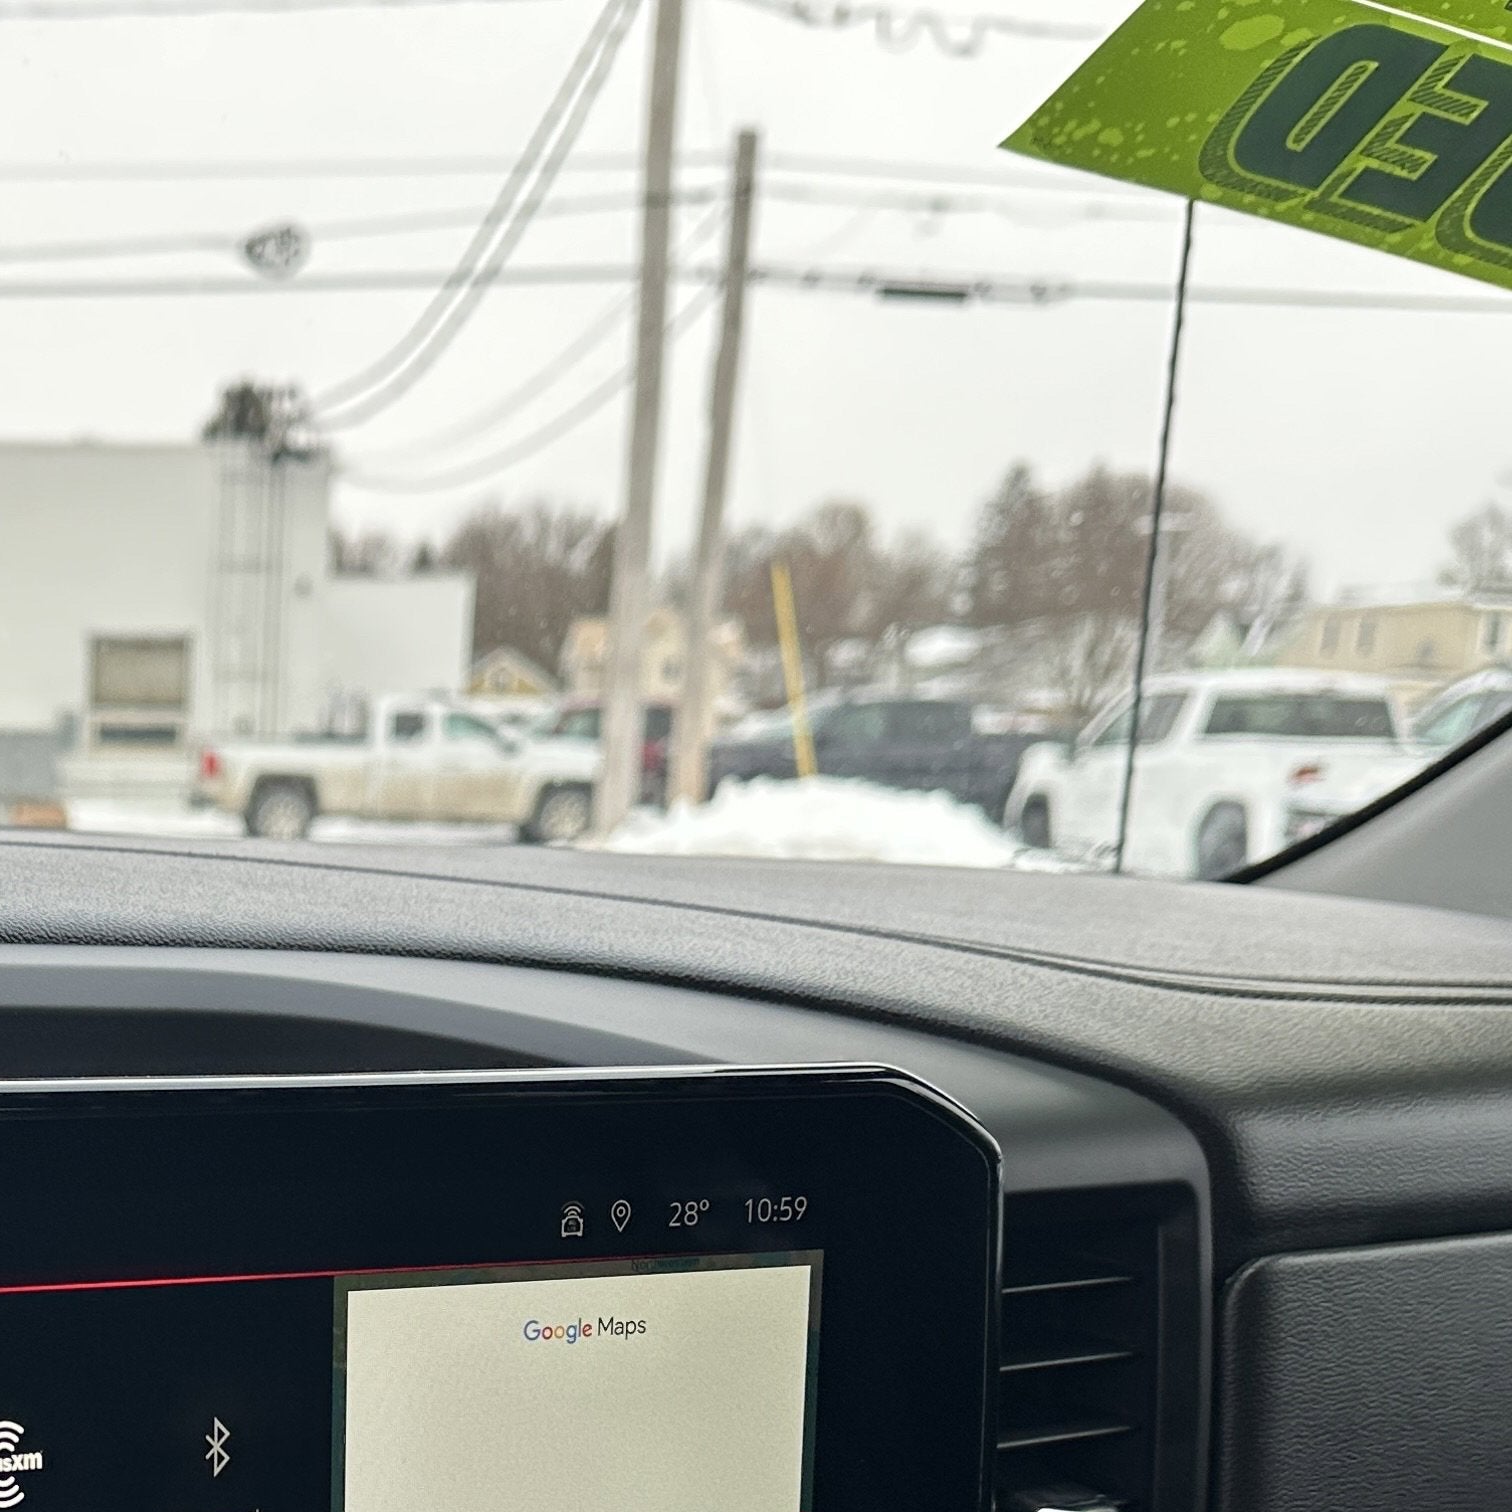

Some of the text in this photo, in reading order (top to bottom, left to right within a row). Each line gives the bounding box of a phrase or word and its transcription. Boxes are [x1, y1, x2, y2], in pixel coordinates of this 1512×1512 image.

[745, 1197, 808, 1223] 10:59
[524, 1317, 647, 1344] Google Maps
